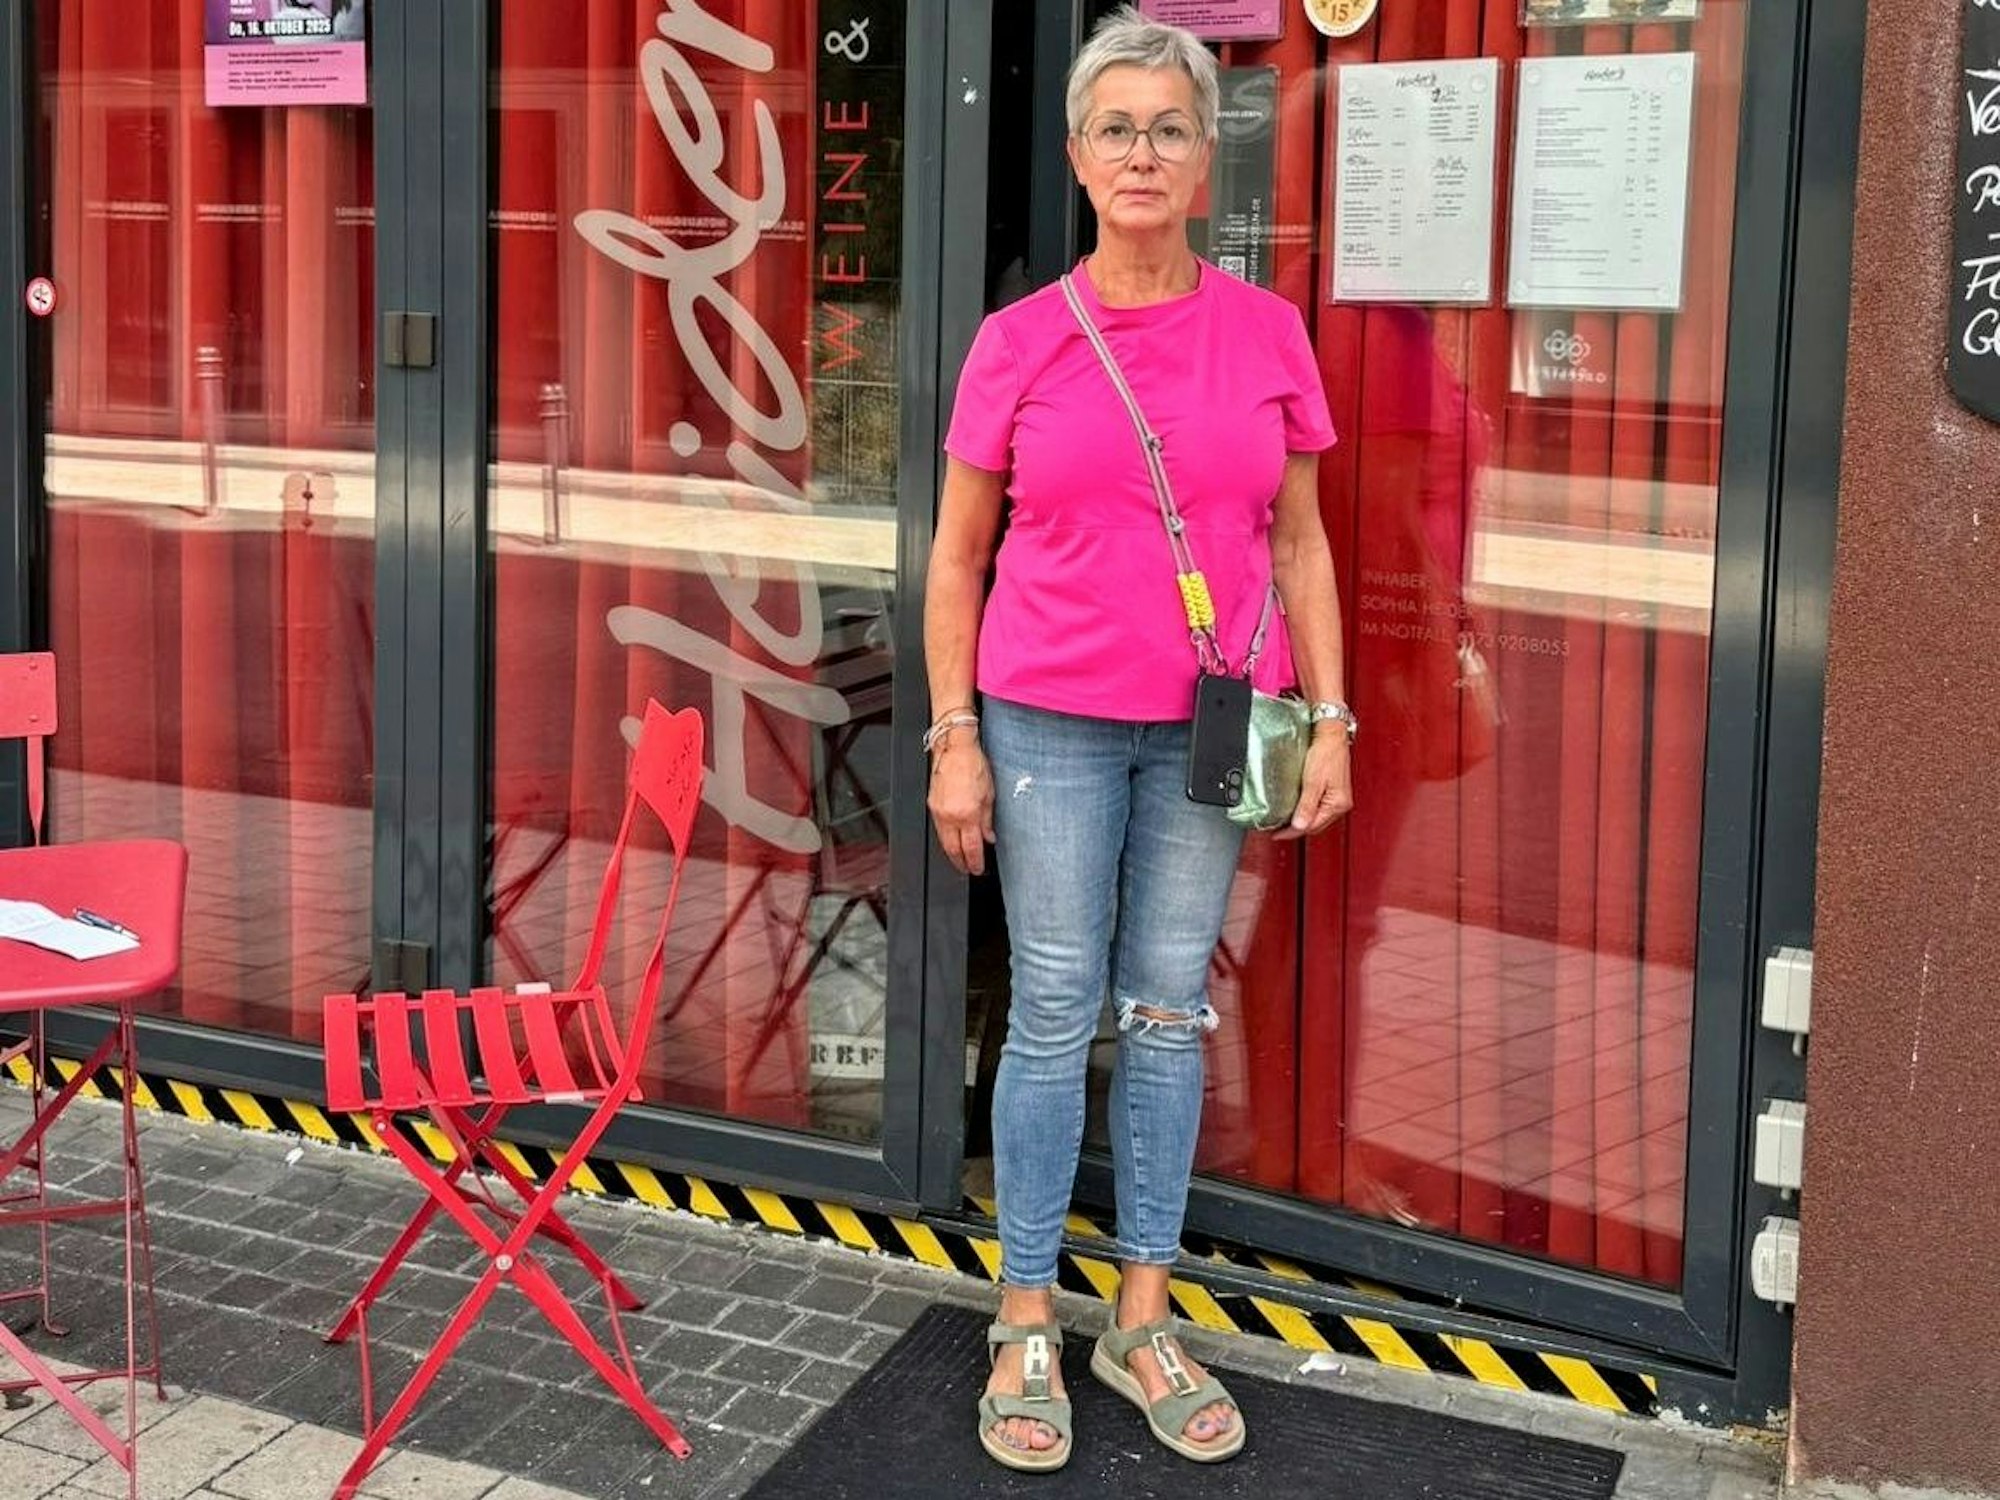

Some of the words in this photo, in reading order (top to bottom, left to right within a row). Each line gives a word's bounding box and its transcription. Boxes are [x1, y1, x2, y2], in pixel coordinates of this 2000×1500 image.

[1331, 3, 1349, 21] 15
[264, 20, 304, 35] OKTOBER
[306, 19, 331, 34] 2025
[824, 17, 869, 63] &
[821, 100, 869, 371] WEINE
[1498, 634, 1570, 655] 9208053
